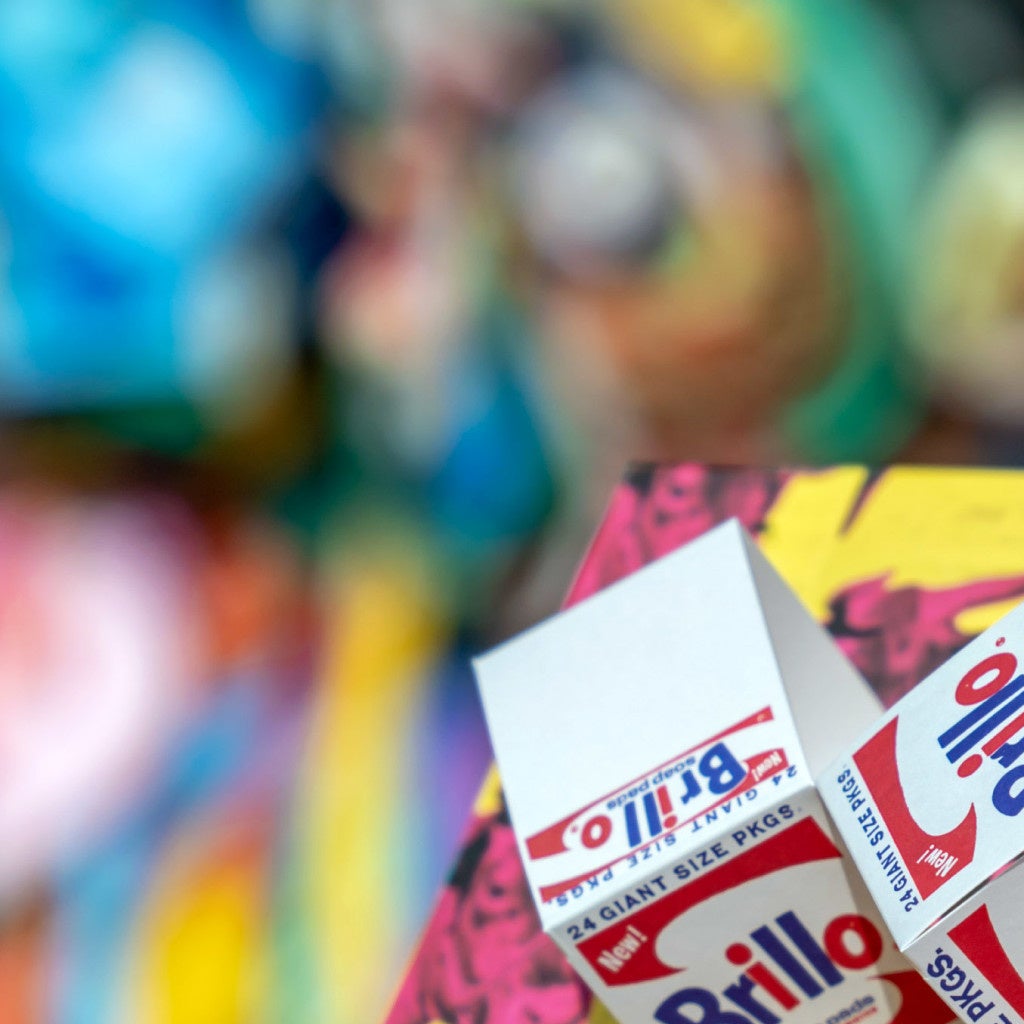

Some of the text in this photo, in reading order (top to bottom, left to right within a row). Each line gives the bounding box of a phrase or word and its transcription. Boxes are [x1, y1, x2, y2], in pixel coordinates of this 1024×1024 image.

[580, 741, 747, 850] Brillo
[606, 756, 696, 810] soap pads
[771, 764, 798, 786] 24
[691, 788, 758, 833] GIANT
[858, 807, 884, 846] SIZE
[627, 833, 676, 867] SIZE
[876, 844, 908, 892] GIANT
[916, 844, 958, 877] New!
[566, 918, 597, 940] 24
[600, 876, 667, 921] GIANT
[673, 843, 729, 880] SIZE
[900, 889, 919, 912] 24
[597, 924, 648, 973] New!
[927, 947, 995, 1023] PKGS.
